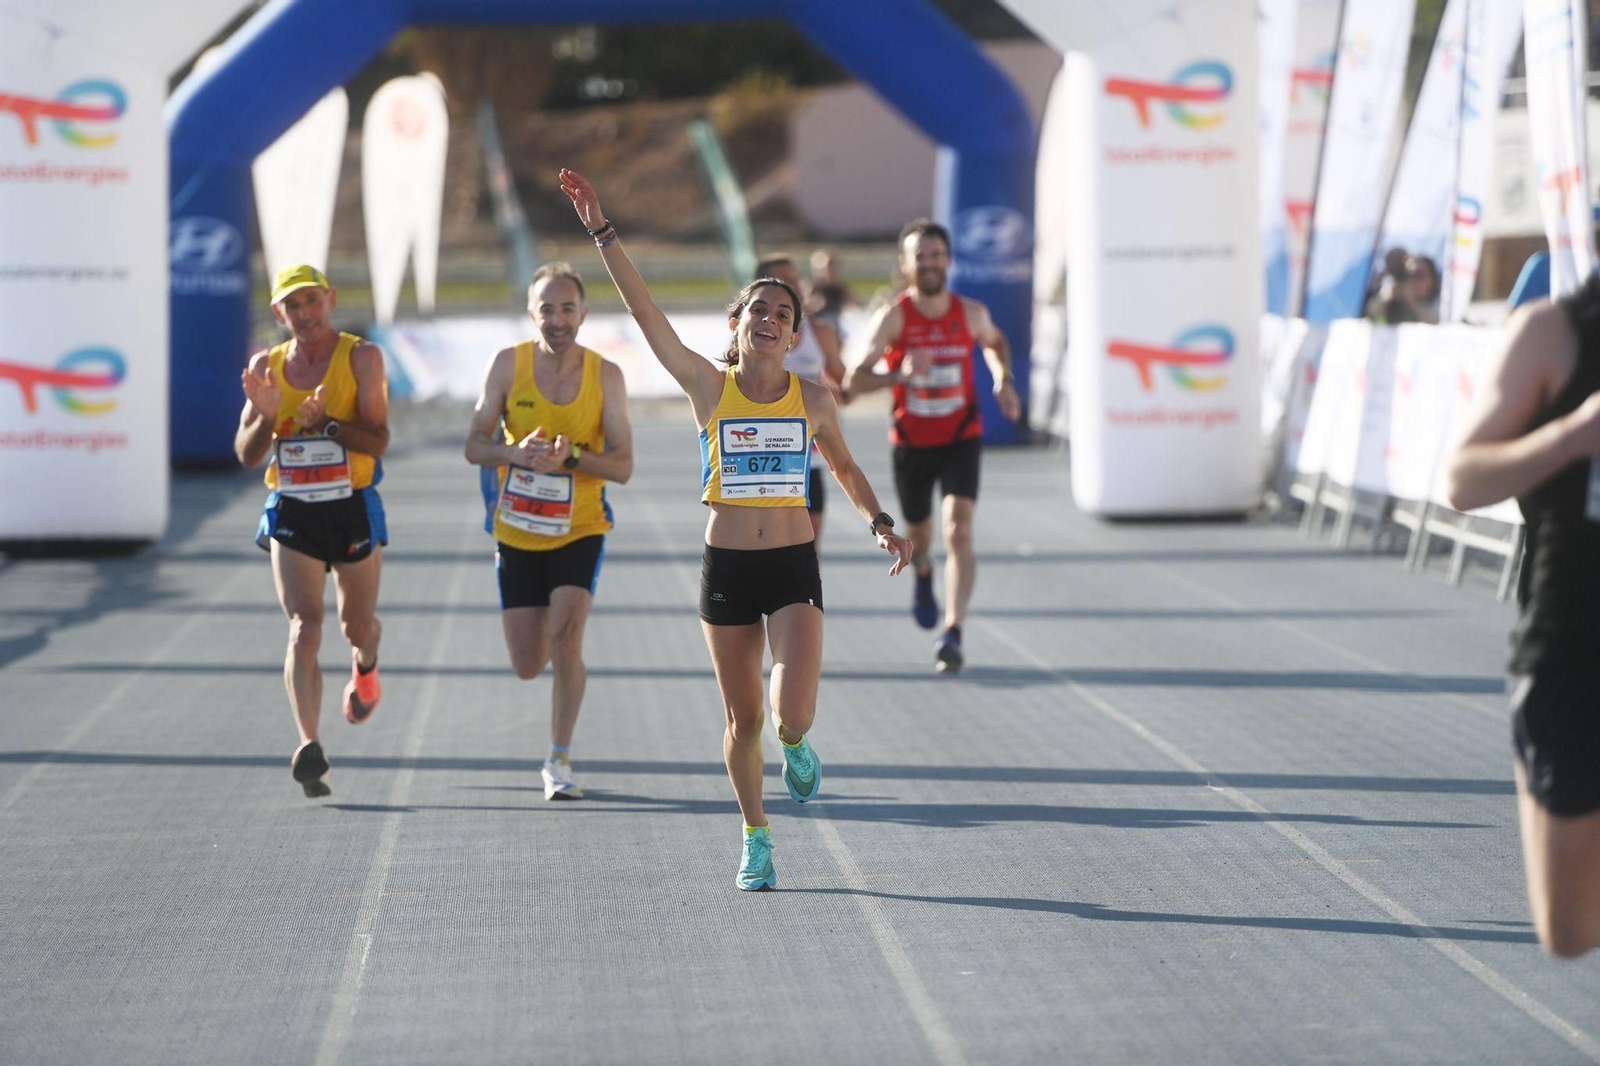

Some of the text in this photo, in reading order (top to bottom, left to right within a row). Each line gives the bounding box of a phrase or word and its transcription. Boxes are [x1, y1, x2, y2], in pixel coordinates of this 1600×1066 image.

[0, 164, 128, 187] otalEnergies
[0, 429, 127, 452] otalEnergies
[748, 456, 782, 473] 672
